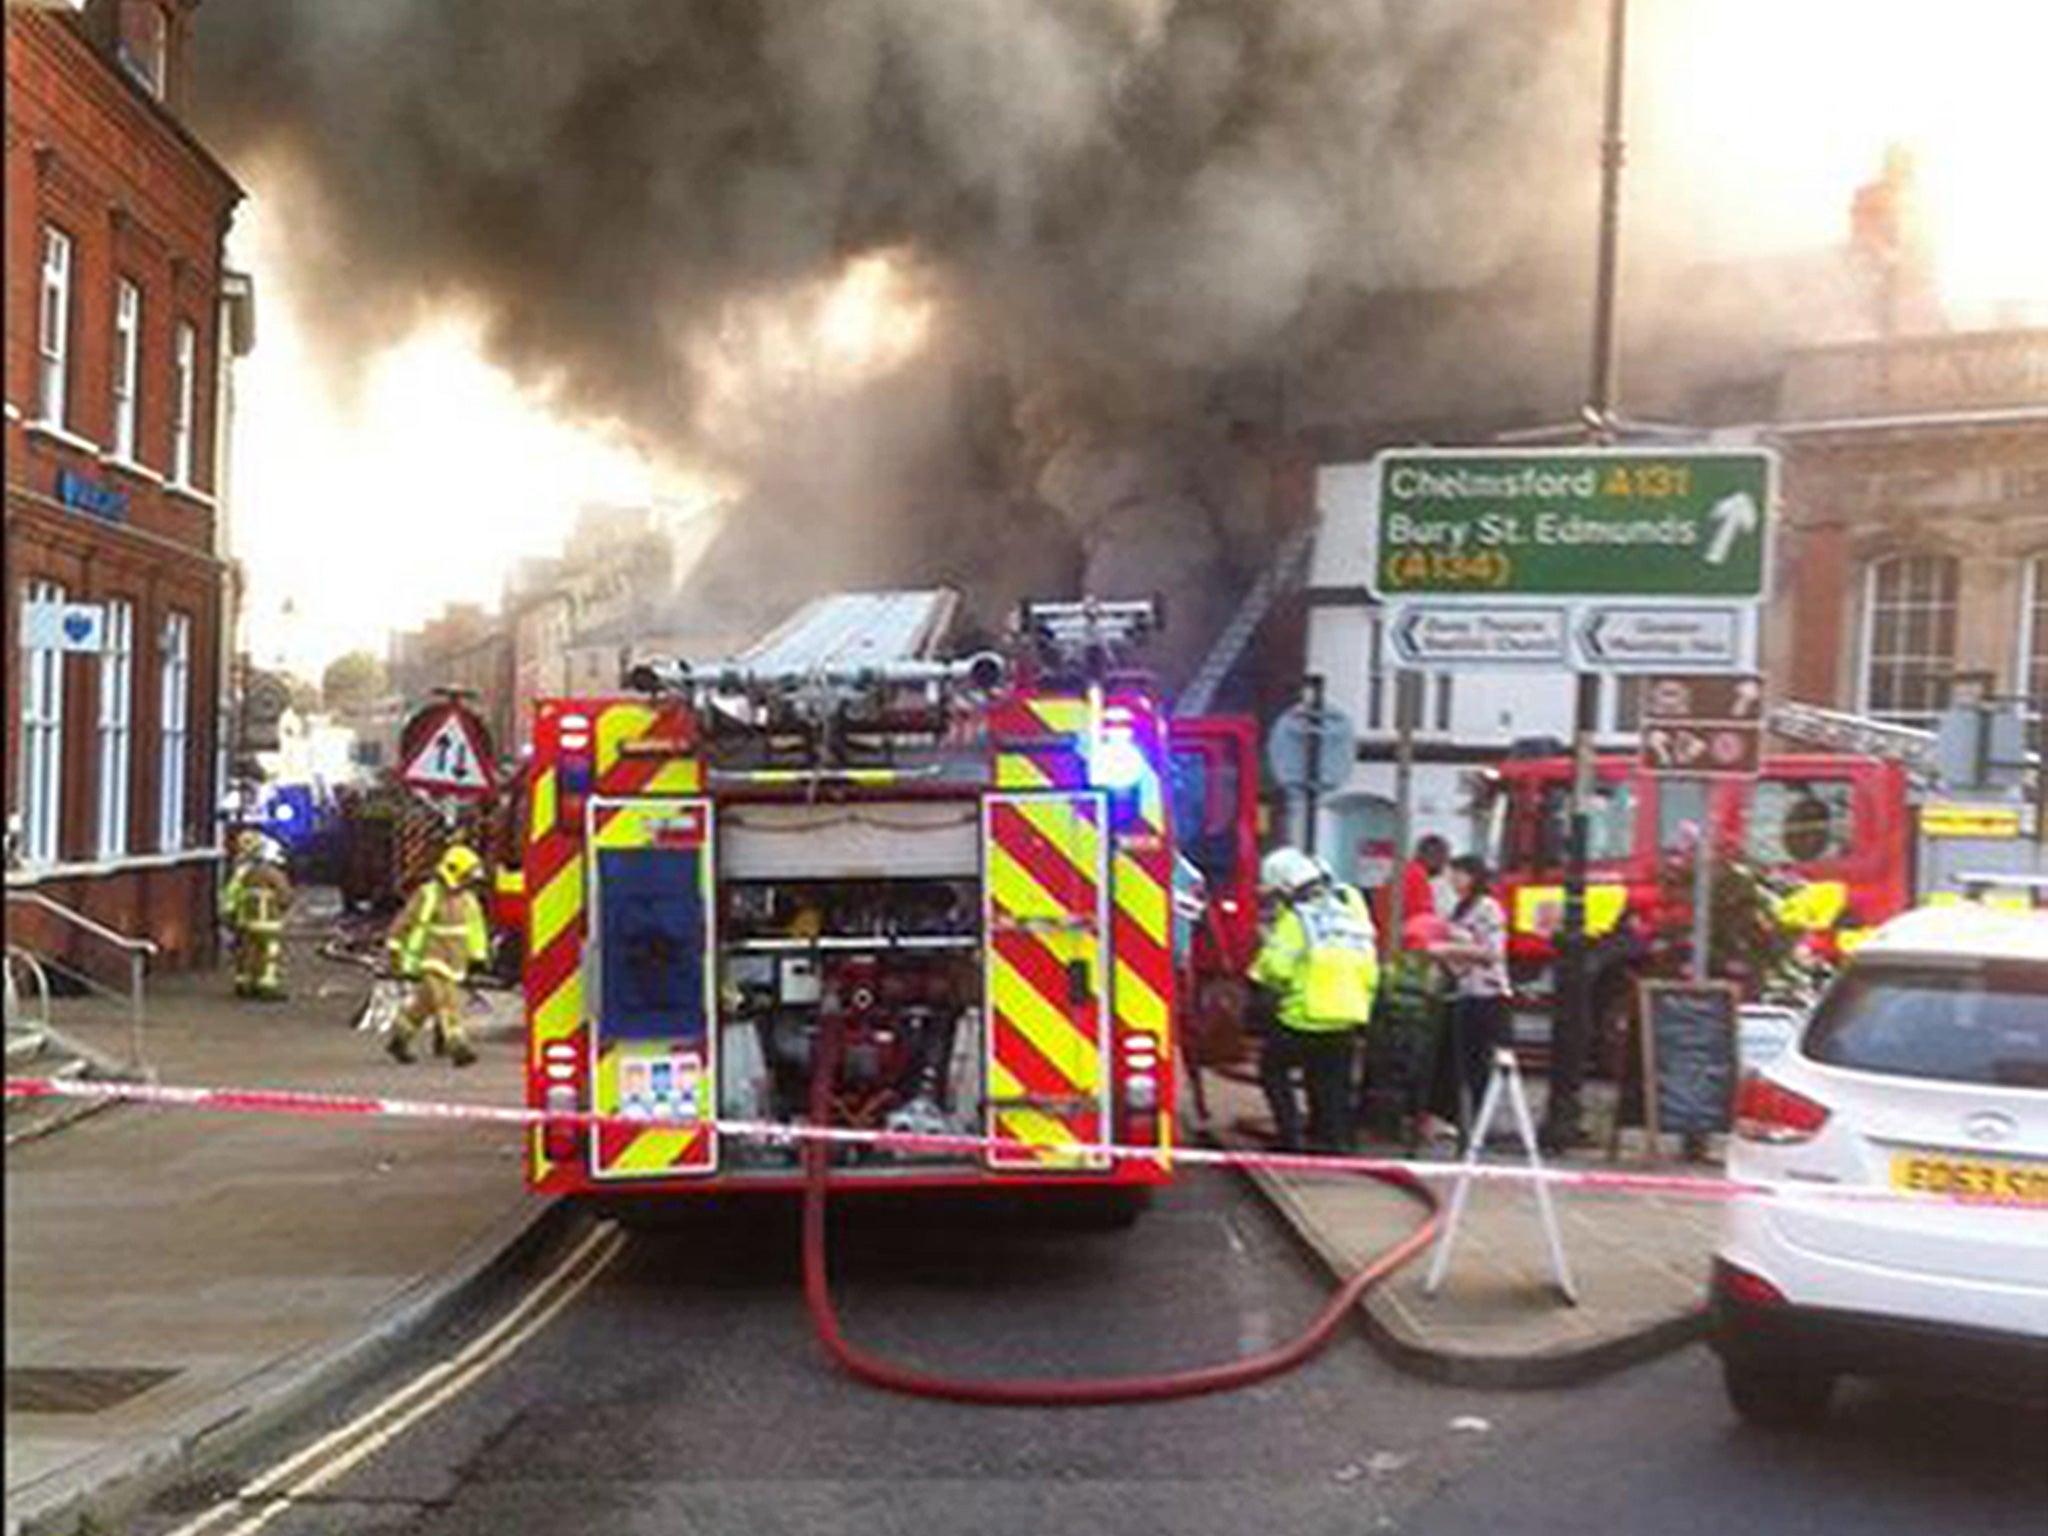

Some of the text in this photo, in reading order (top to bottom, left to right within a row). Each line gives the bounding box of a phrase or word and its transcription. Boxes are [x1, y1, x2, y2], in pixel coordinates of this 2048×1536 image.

[1389, 466, 1692, 499] Chelmsford A131
[1388, 512, 1468, 555] Bury
[1535, 511, 1697, 546] Edmunds
